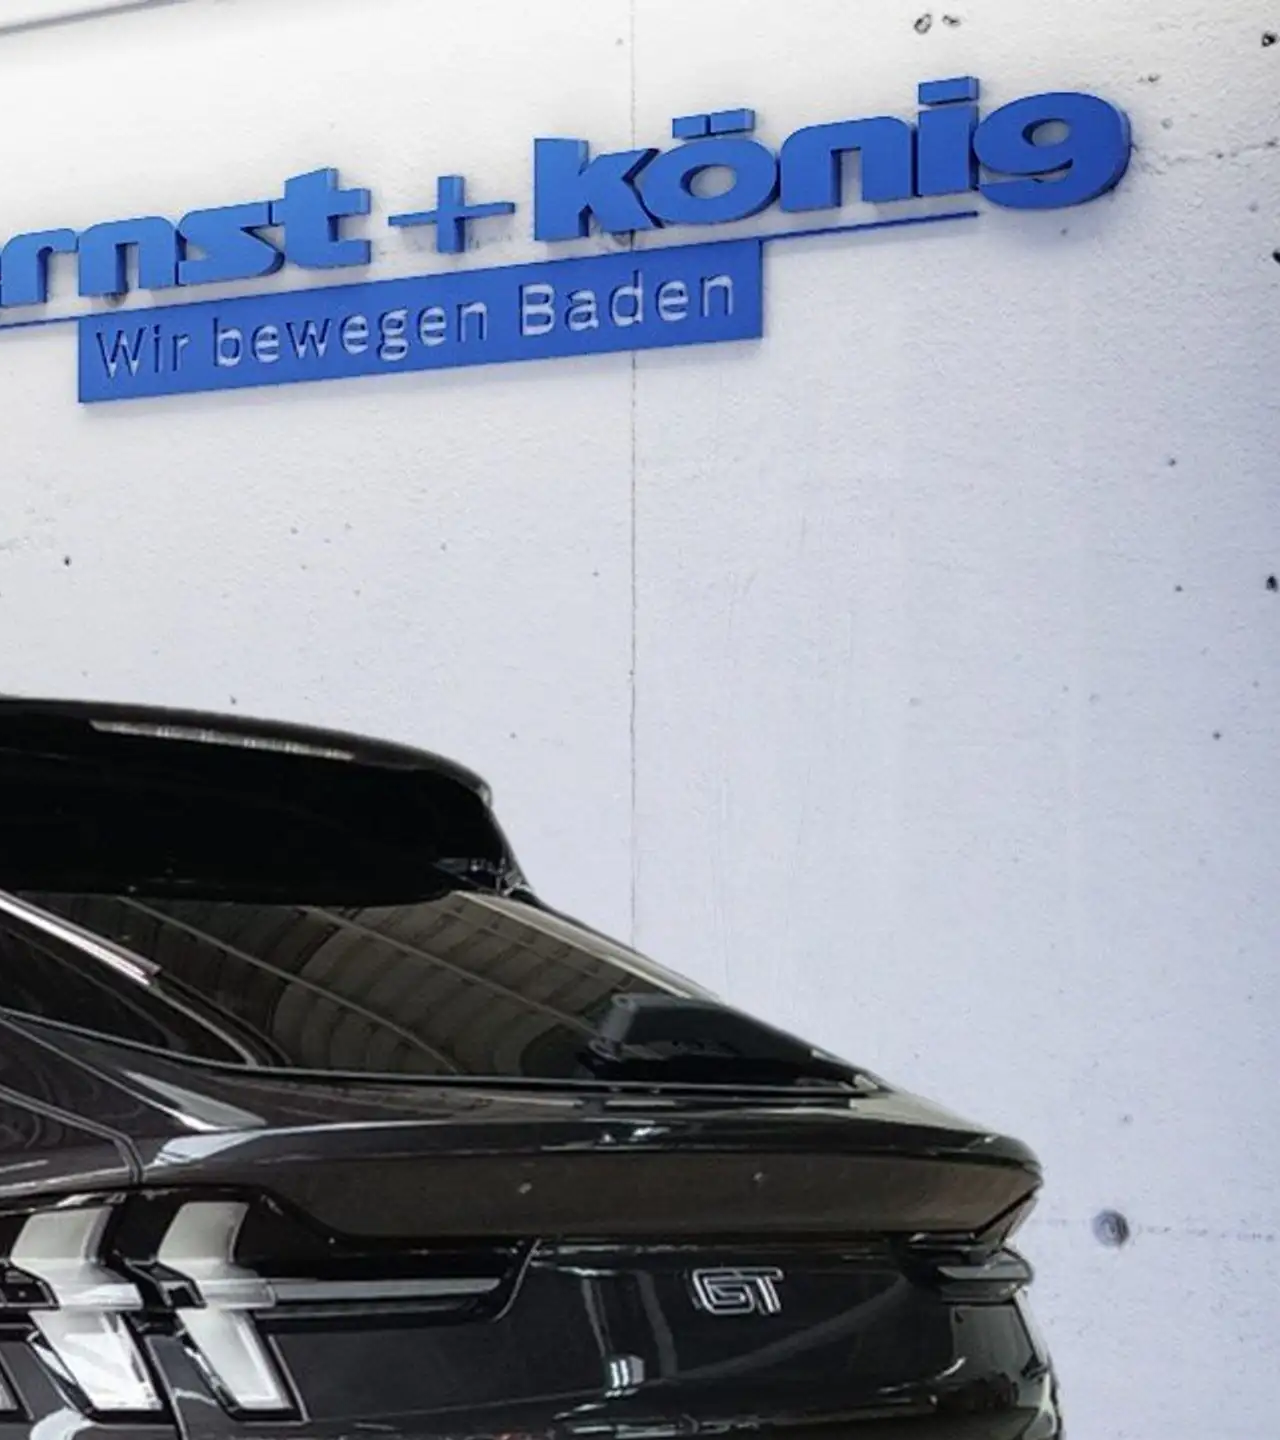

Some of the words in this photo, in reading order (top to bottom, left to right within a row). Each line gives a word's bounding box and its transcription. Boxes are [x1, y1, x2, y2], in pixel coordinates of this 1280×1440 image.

[94, 325, 190, 378] Wir
[211, 298, 488, 370] bewegen
[517, 270, 736, 337] Baden
[691, 1266, 785, 1315] GT
